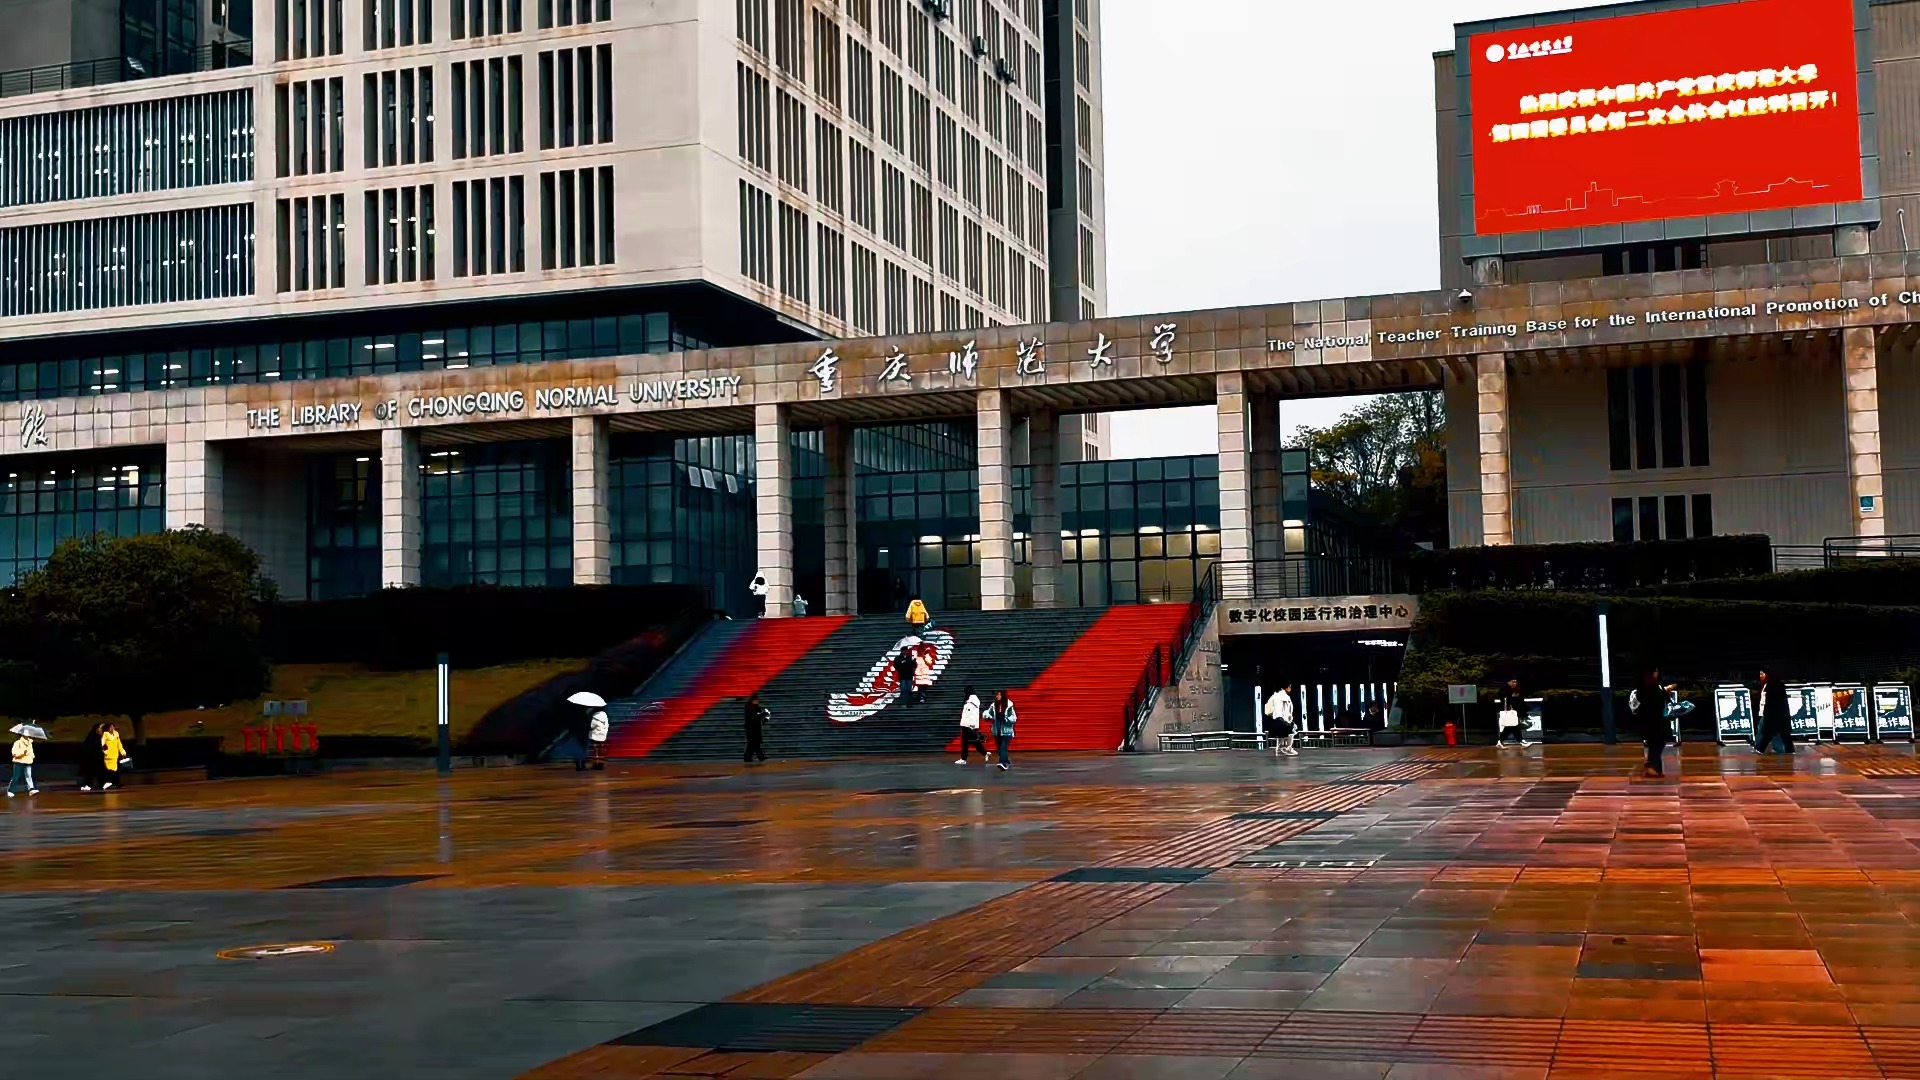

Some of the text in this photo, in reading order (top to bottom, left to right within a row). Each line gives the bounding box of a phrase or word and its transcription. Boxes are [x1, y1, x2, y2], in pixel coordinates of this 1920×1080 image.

[1267, 338, 1295, 351] The
[1303, 333, 1369, 349] National
[1377, 329, 1442, 344] Teacher
[1451, 322, 1517, 339] Training
[1526, 318, 1567, 333] Base
[1574, 316, 1598, 329] for
[1609, 313, 1636, 327] the
[1645, 303, 1757, 323] International
[1766, 297, 1859, 315] Promotion
[1868, 293, 1888, 307] of
[808, 323, 1176, 393] 重庆师范大学
[247, 375, 742, 429] THE LIBRARY OF CHONGQING NORMAL UNIVERSITY
[1228, 604, 1409, 623] 数字化校园运行和治理中心
